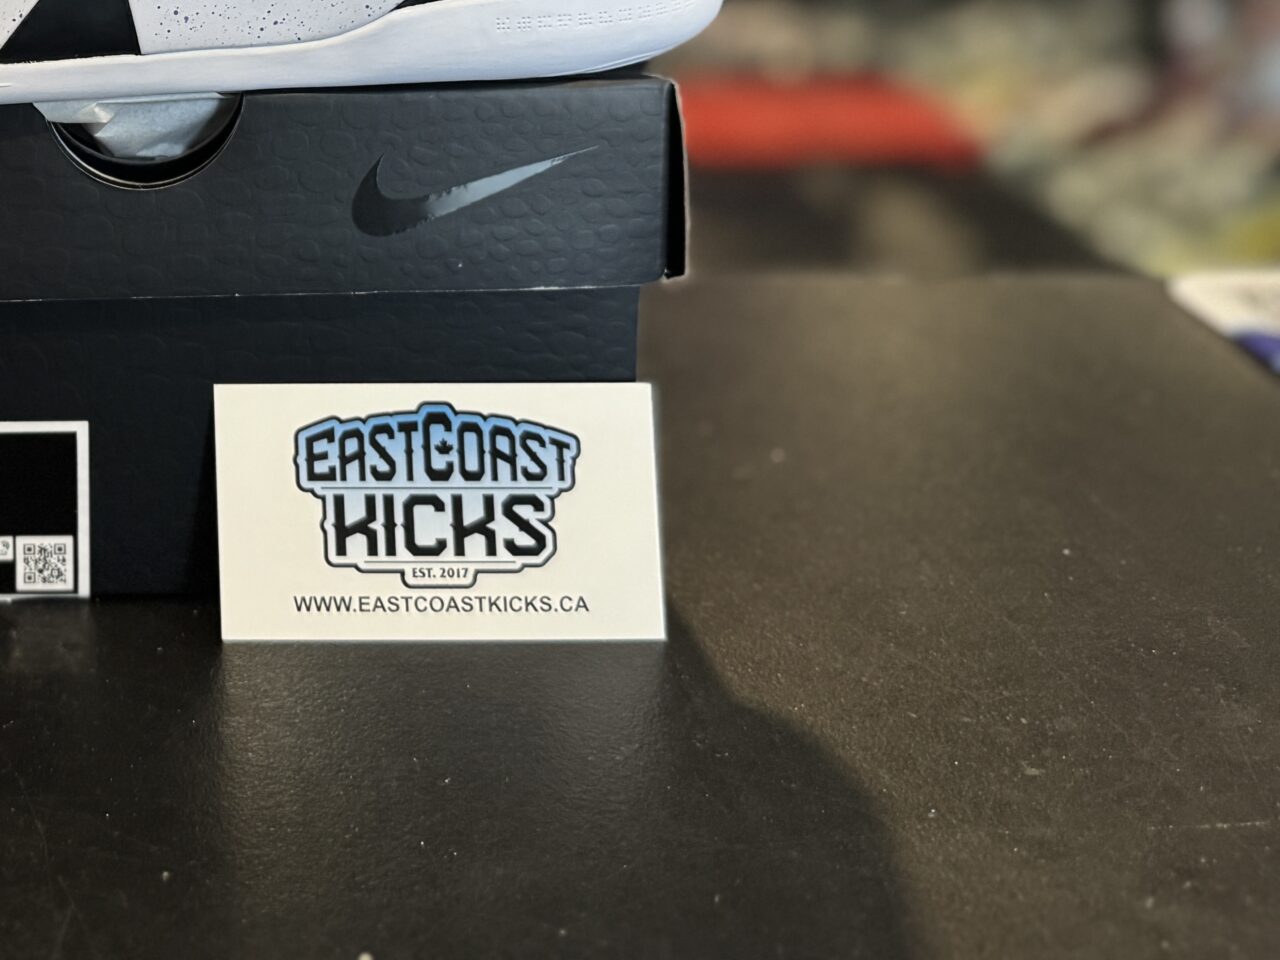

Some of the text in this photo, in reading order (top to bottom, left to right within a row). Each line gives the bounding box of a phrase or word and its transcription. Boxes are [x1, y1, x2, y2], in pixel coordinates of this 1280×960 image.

[332, 493, 548, 557] KICKS
[411, 567, 469, 579] EST. 2017
[293, 595, 590, 613] WWW.EASTCOASTKICKS.CA
